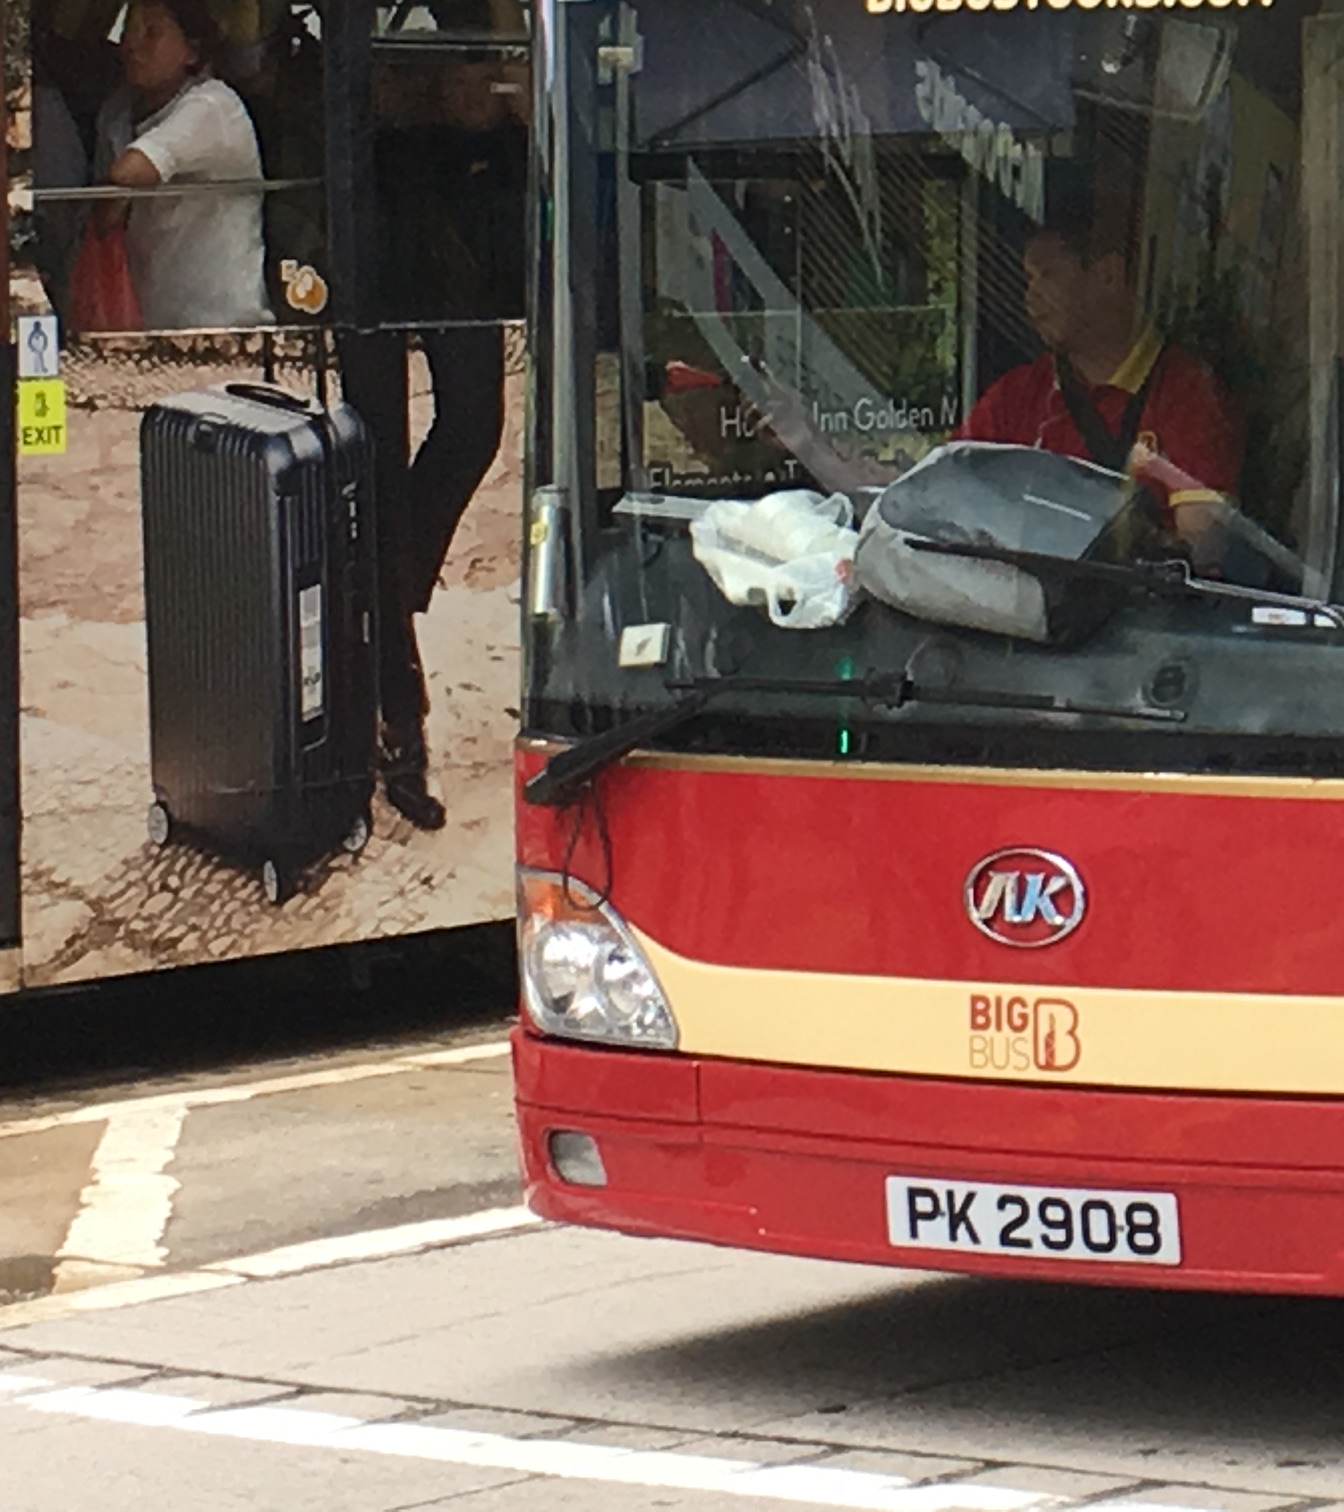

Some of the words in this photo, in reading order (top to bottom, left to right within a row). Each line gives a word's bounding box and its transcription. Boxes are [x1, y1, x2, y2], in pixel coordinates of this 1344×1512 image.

[854, 396, 935, 431] Golden
[22, 424, 63, 445] EXIT
[969, 993, 1030, 1034] BIG
[968, 1034, 1031, 1072] BUS
[906, 1185, 982, 1246] PK
[996, 1193, 1163, 1256] 2908
